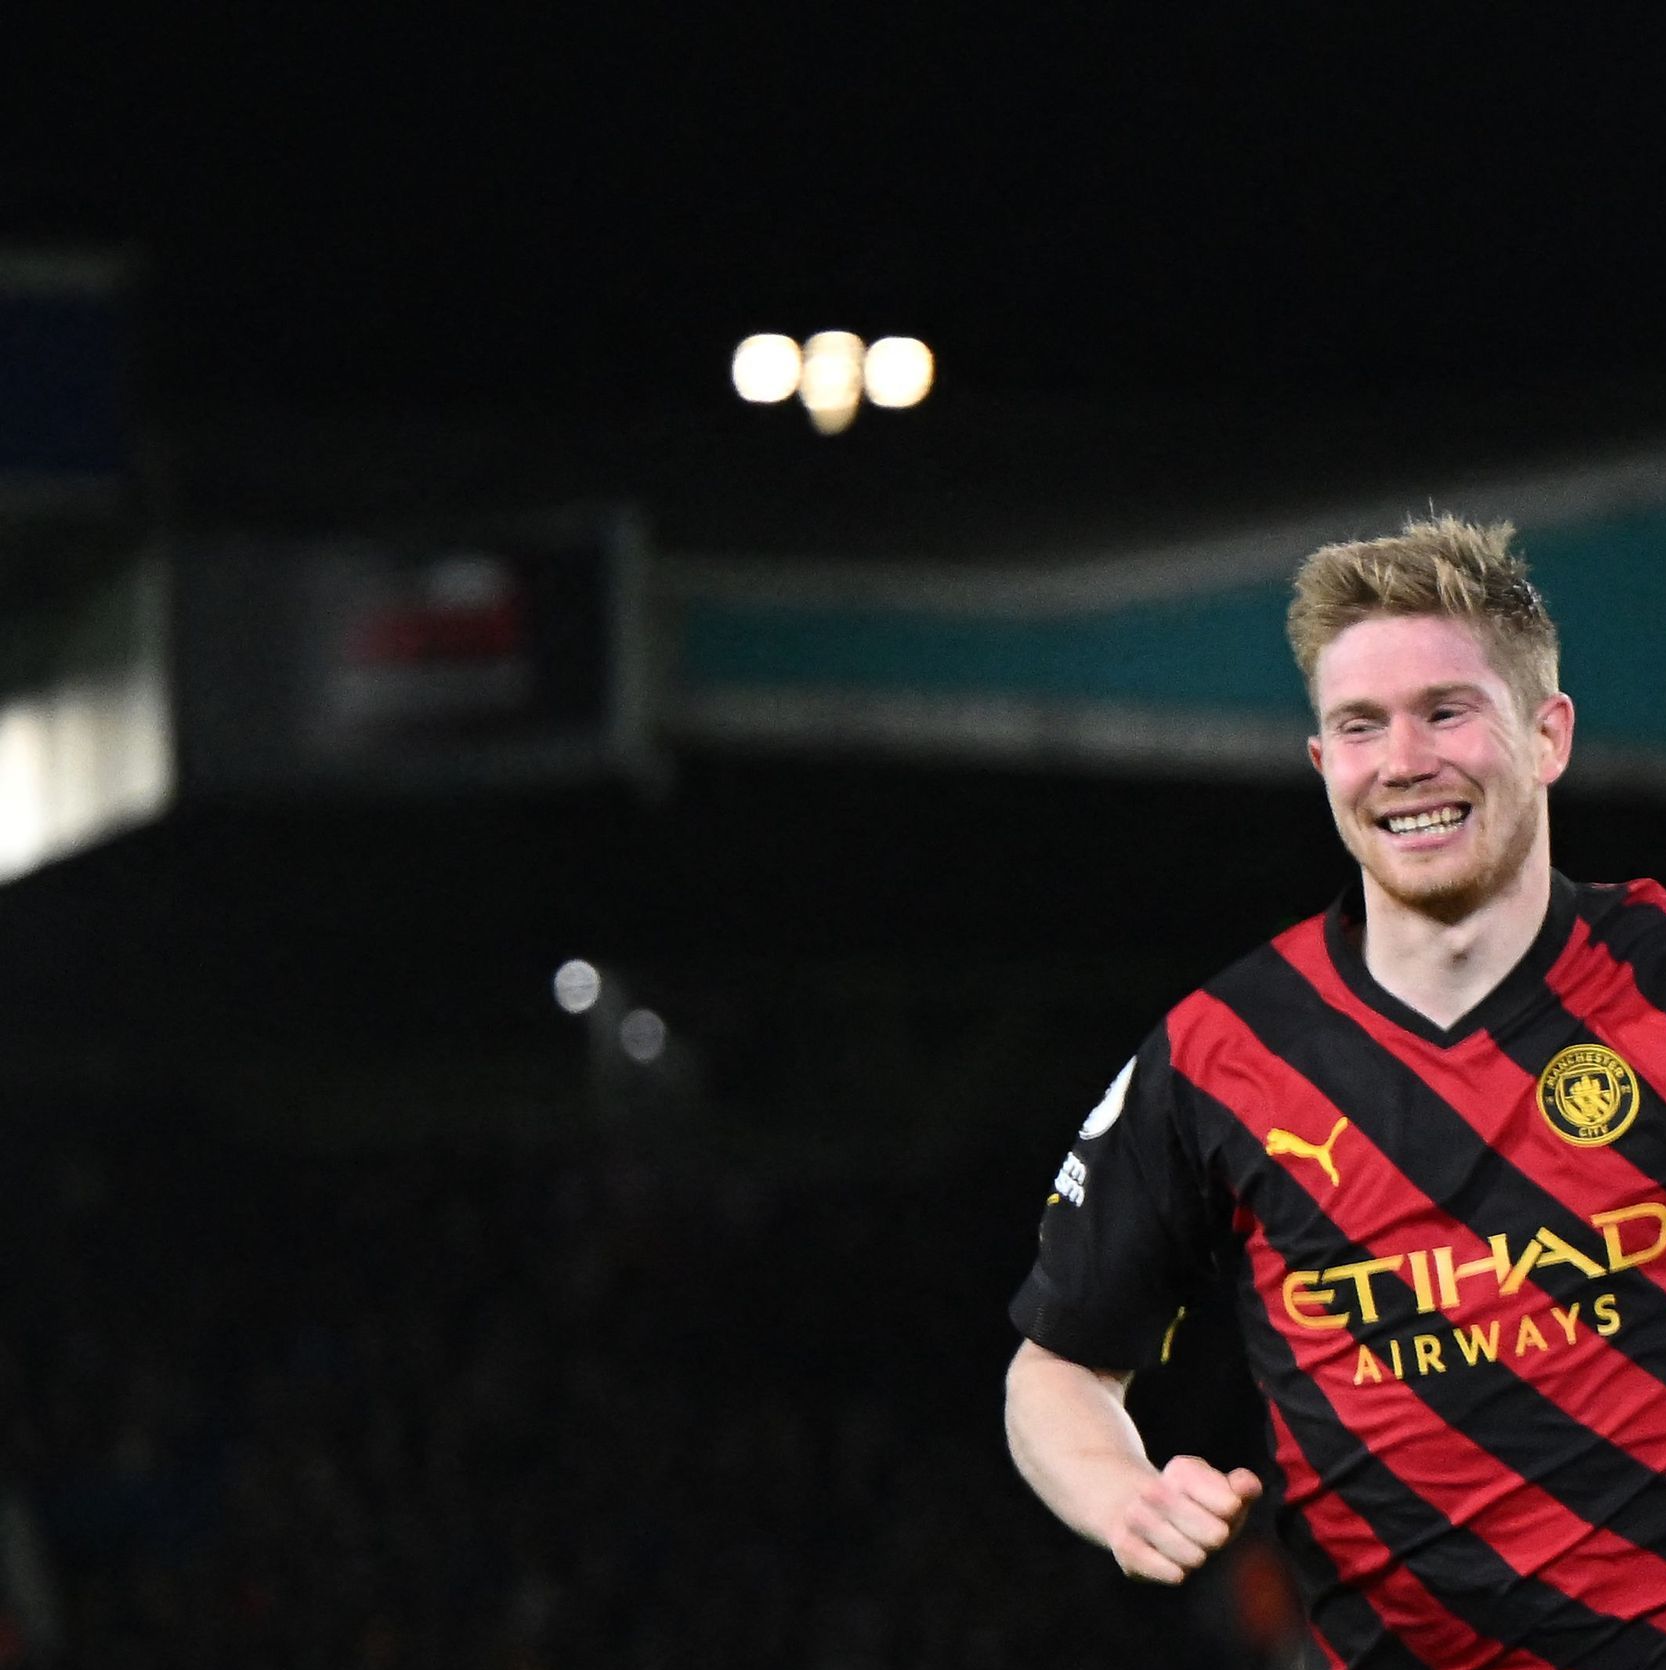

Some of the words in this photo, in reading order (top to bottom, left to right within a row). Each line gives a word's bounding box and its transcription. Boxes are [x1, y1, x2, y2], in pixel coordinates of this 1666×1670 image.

[1546, 1052, 1625, 1089] MANCHESTER
[1578, 1123, 1609, 1138] CITY
[1353, 1293, 1622, 1386] AIRWAYS
